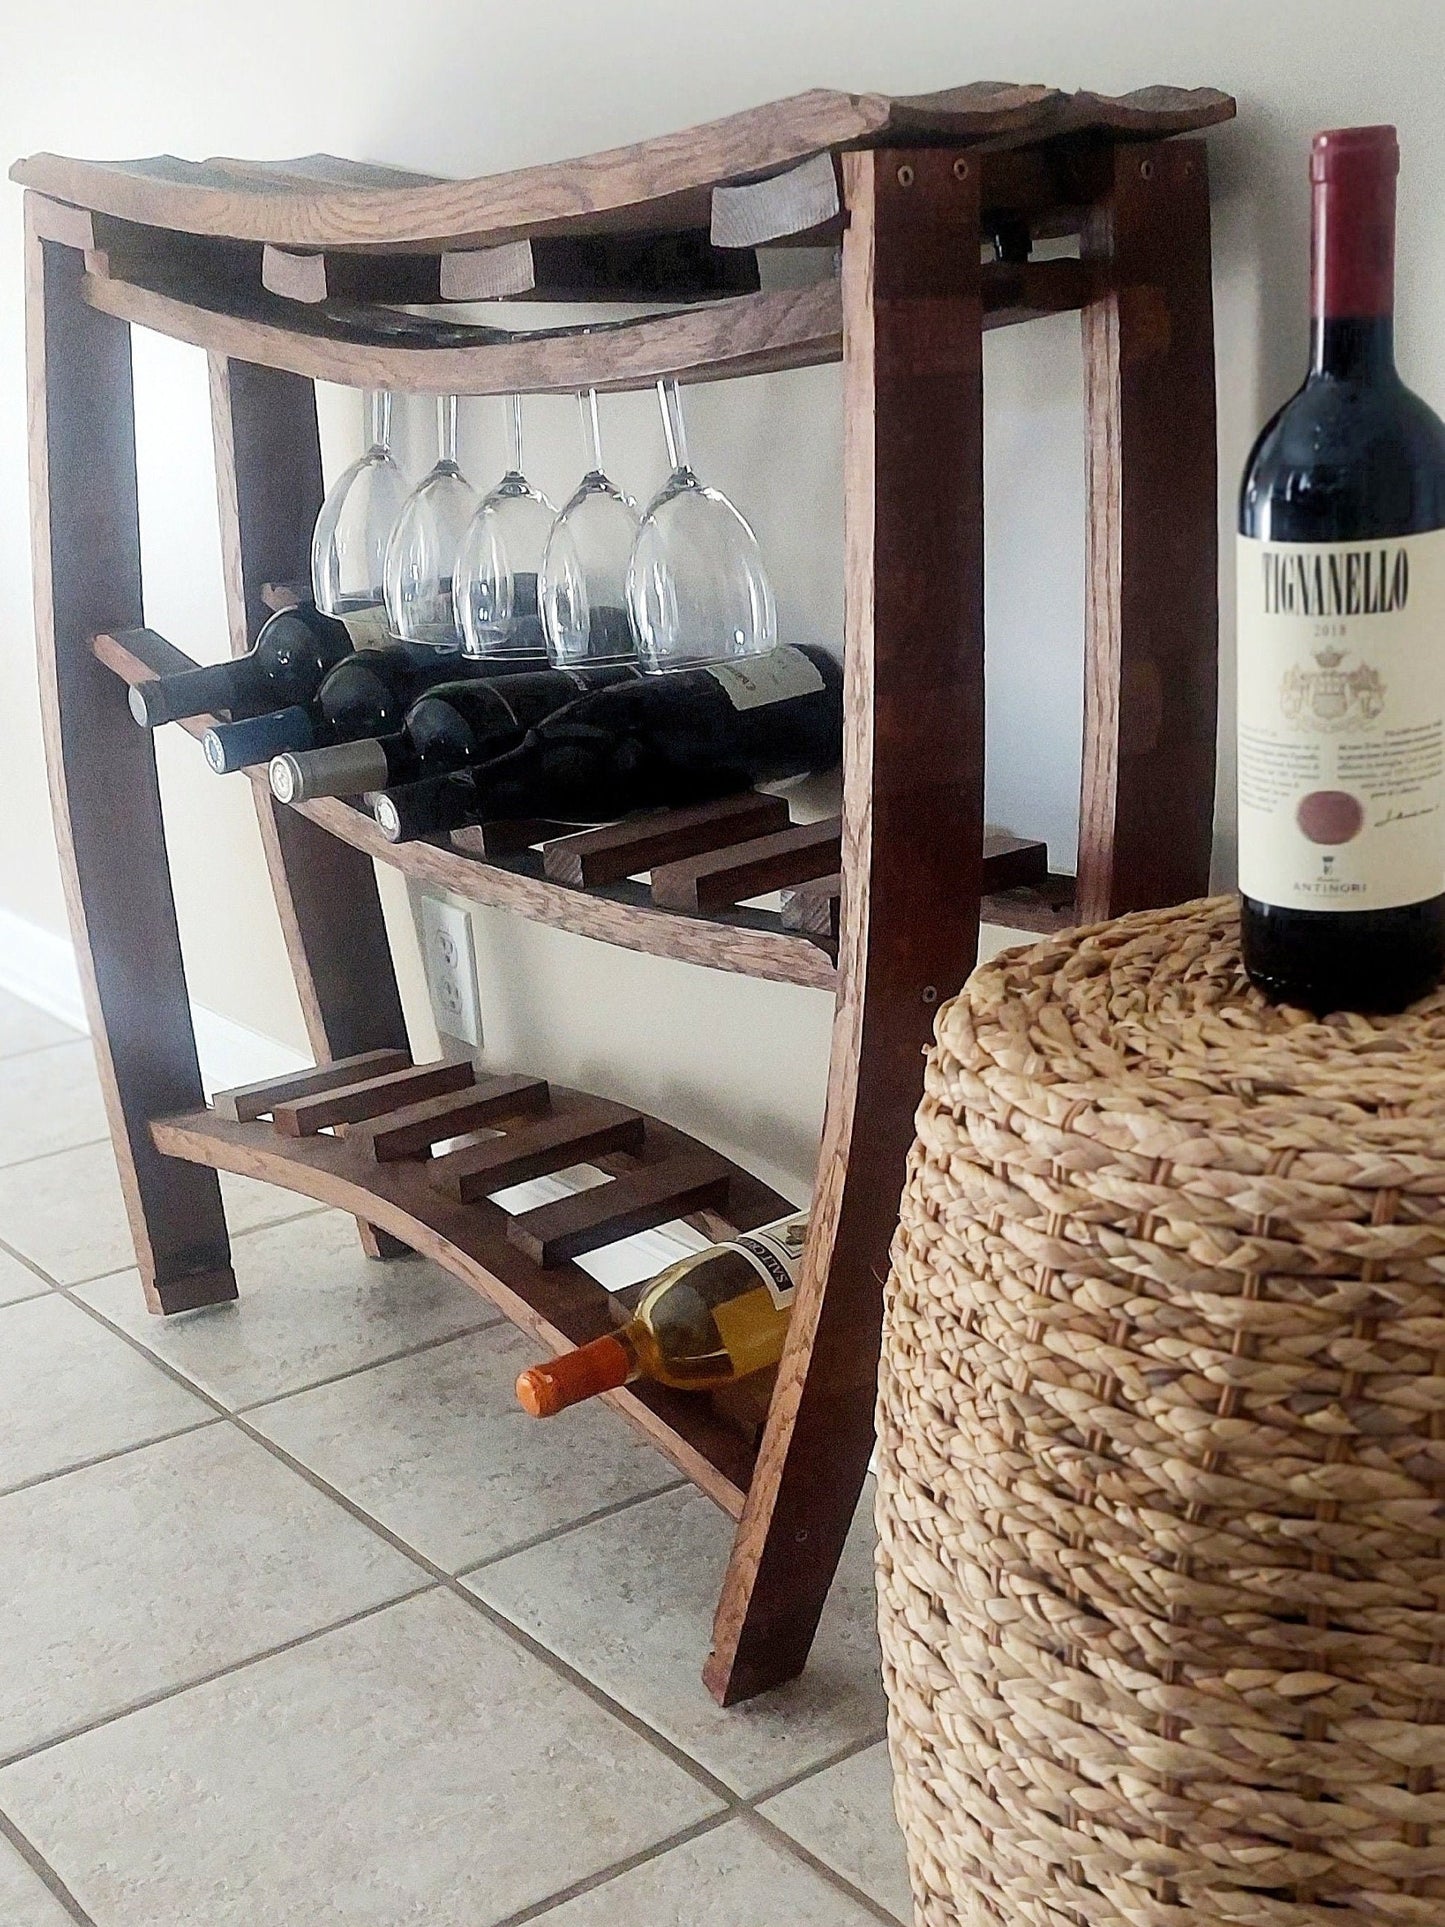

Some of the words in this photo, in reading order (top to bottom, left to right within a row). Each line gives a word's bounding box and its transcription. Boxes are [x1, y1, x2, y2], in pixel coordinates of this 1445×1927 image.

[1262, 548, 1409, 616] TIGNANELLO
[1294, 882, 1367, 893] ANTINORI
[762, 1255, 790, 1283] SALT
